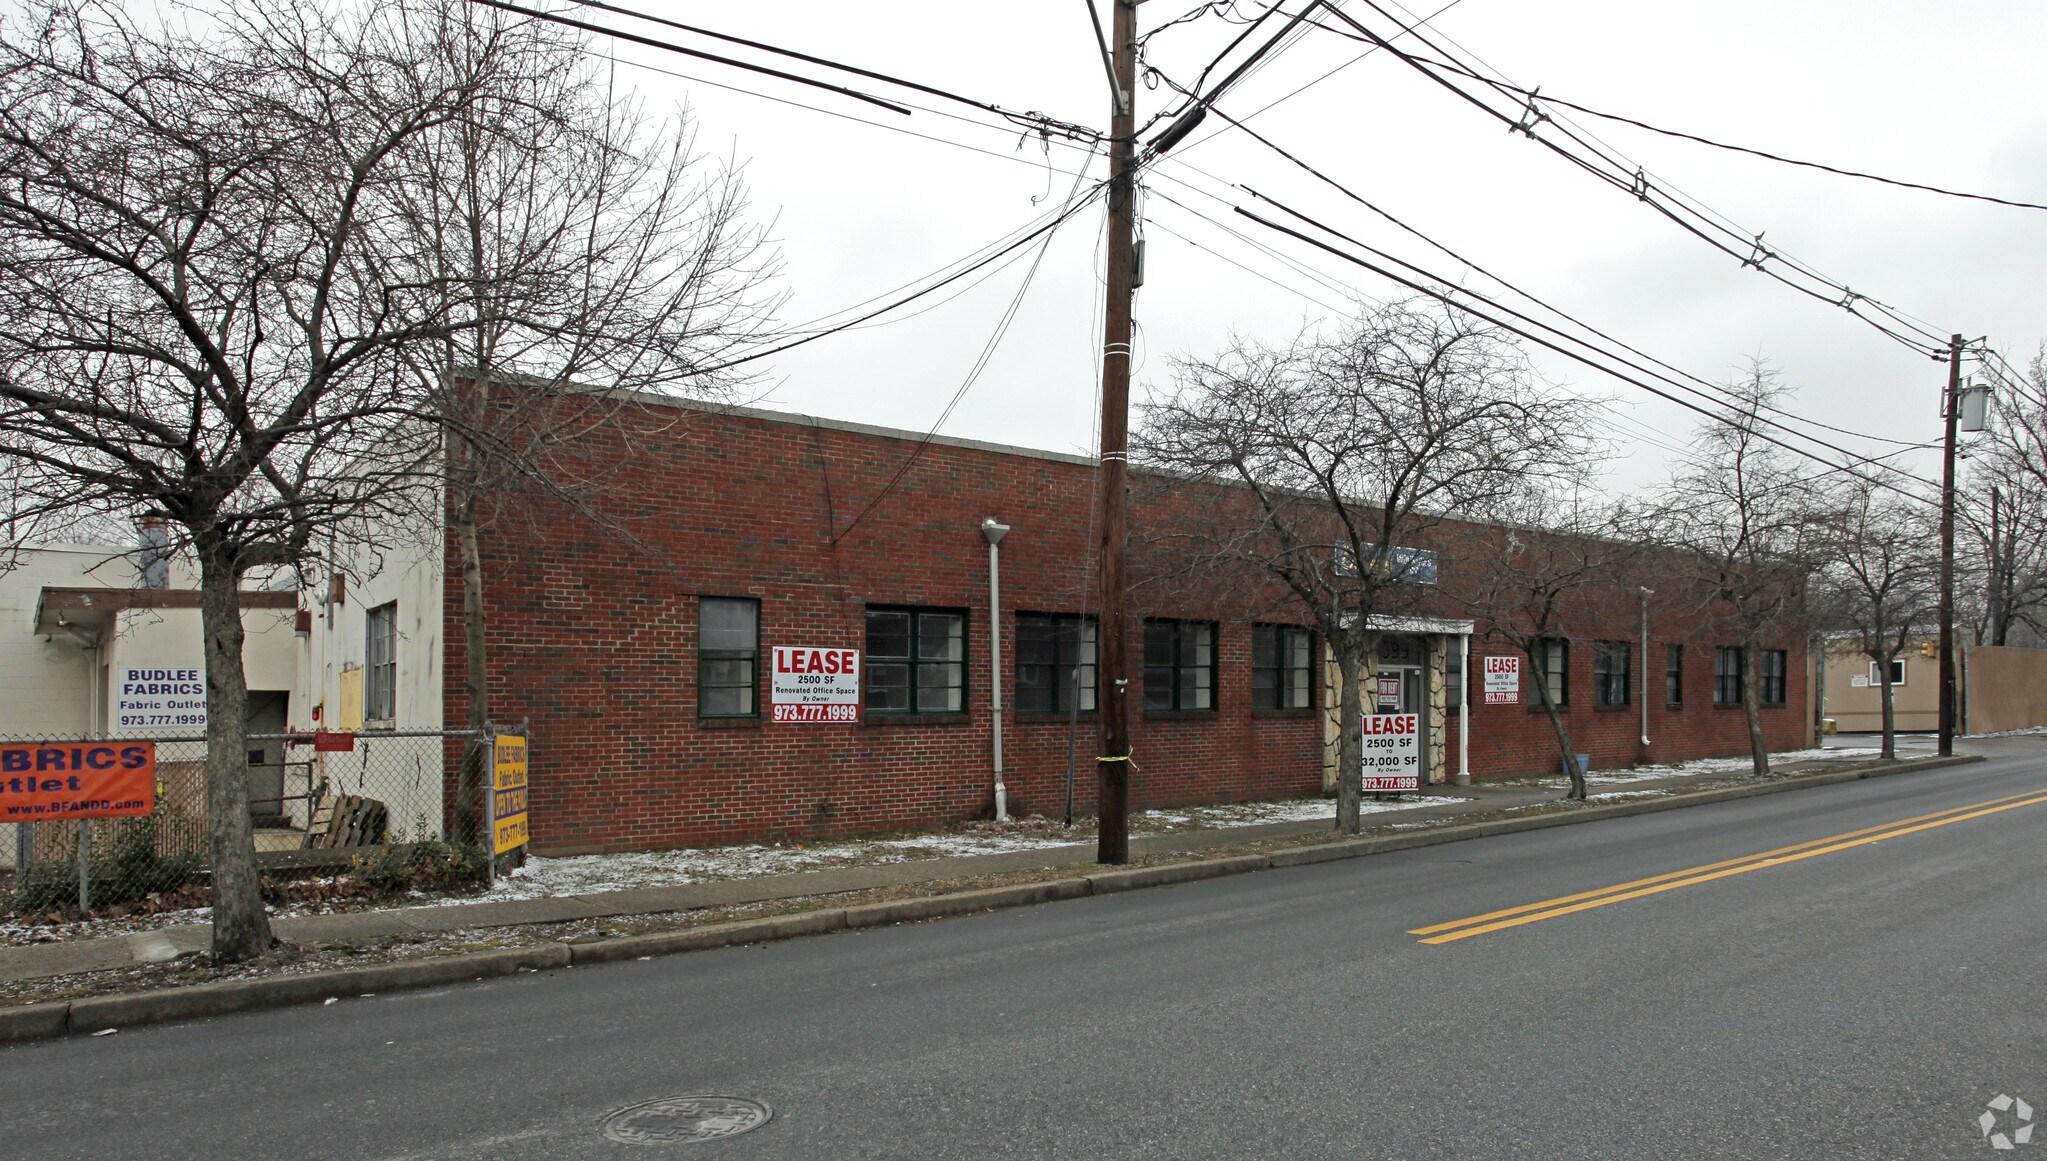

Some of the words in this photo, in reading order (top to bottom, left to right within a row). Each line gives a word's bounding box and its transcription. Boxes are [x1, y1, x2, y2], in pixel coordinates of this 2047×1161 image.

[778, 650, 855, 674] LEASE
[1487, 658, 1517, 673] LEASE
[128, 670, 198, 681] BUDLEE
[798, 675, 820, 684] 2500
[824, 675, 835, 684] SF
[123, 683, 203, 695] FABRICS
[775, 686, 811, 694] Renovated
[835, 687, 856, 695] Space
[1485, 692, 1518, 702] 973.777.1999
[120, 700, 161, 709] Fabric
[167, 700, 207, 709] Outlet
[774, 704, 857, 720] 973.777.1999
[121, 714, 206, 725] 973.777.1999
[1363, 716, 1416, 735] LEASE
[1367, 738, 1394, 748] 2500
[1399, 738, 1412, 748] SF
[0, 746, 148, 772] BRICS
[1361, 756, 1399, 767] 32,000
[1404, 756, 1417, 765] SF
[1362, 777, 1417, 789] 973.777.1999
[8, 800, 144, 814] www.BFANDD.com
